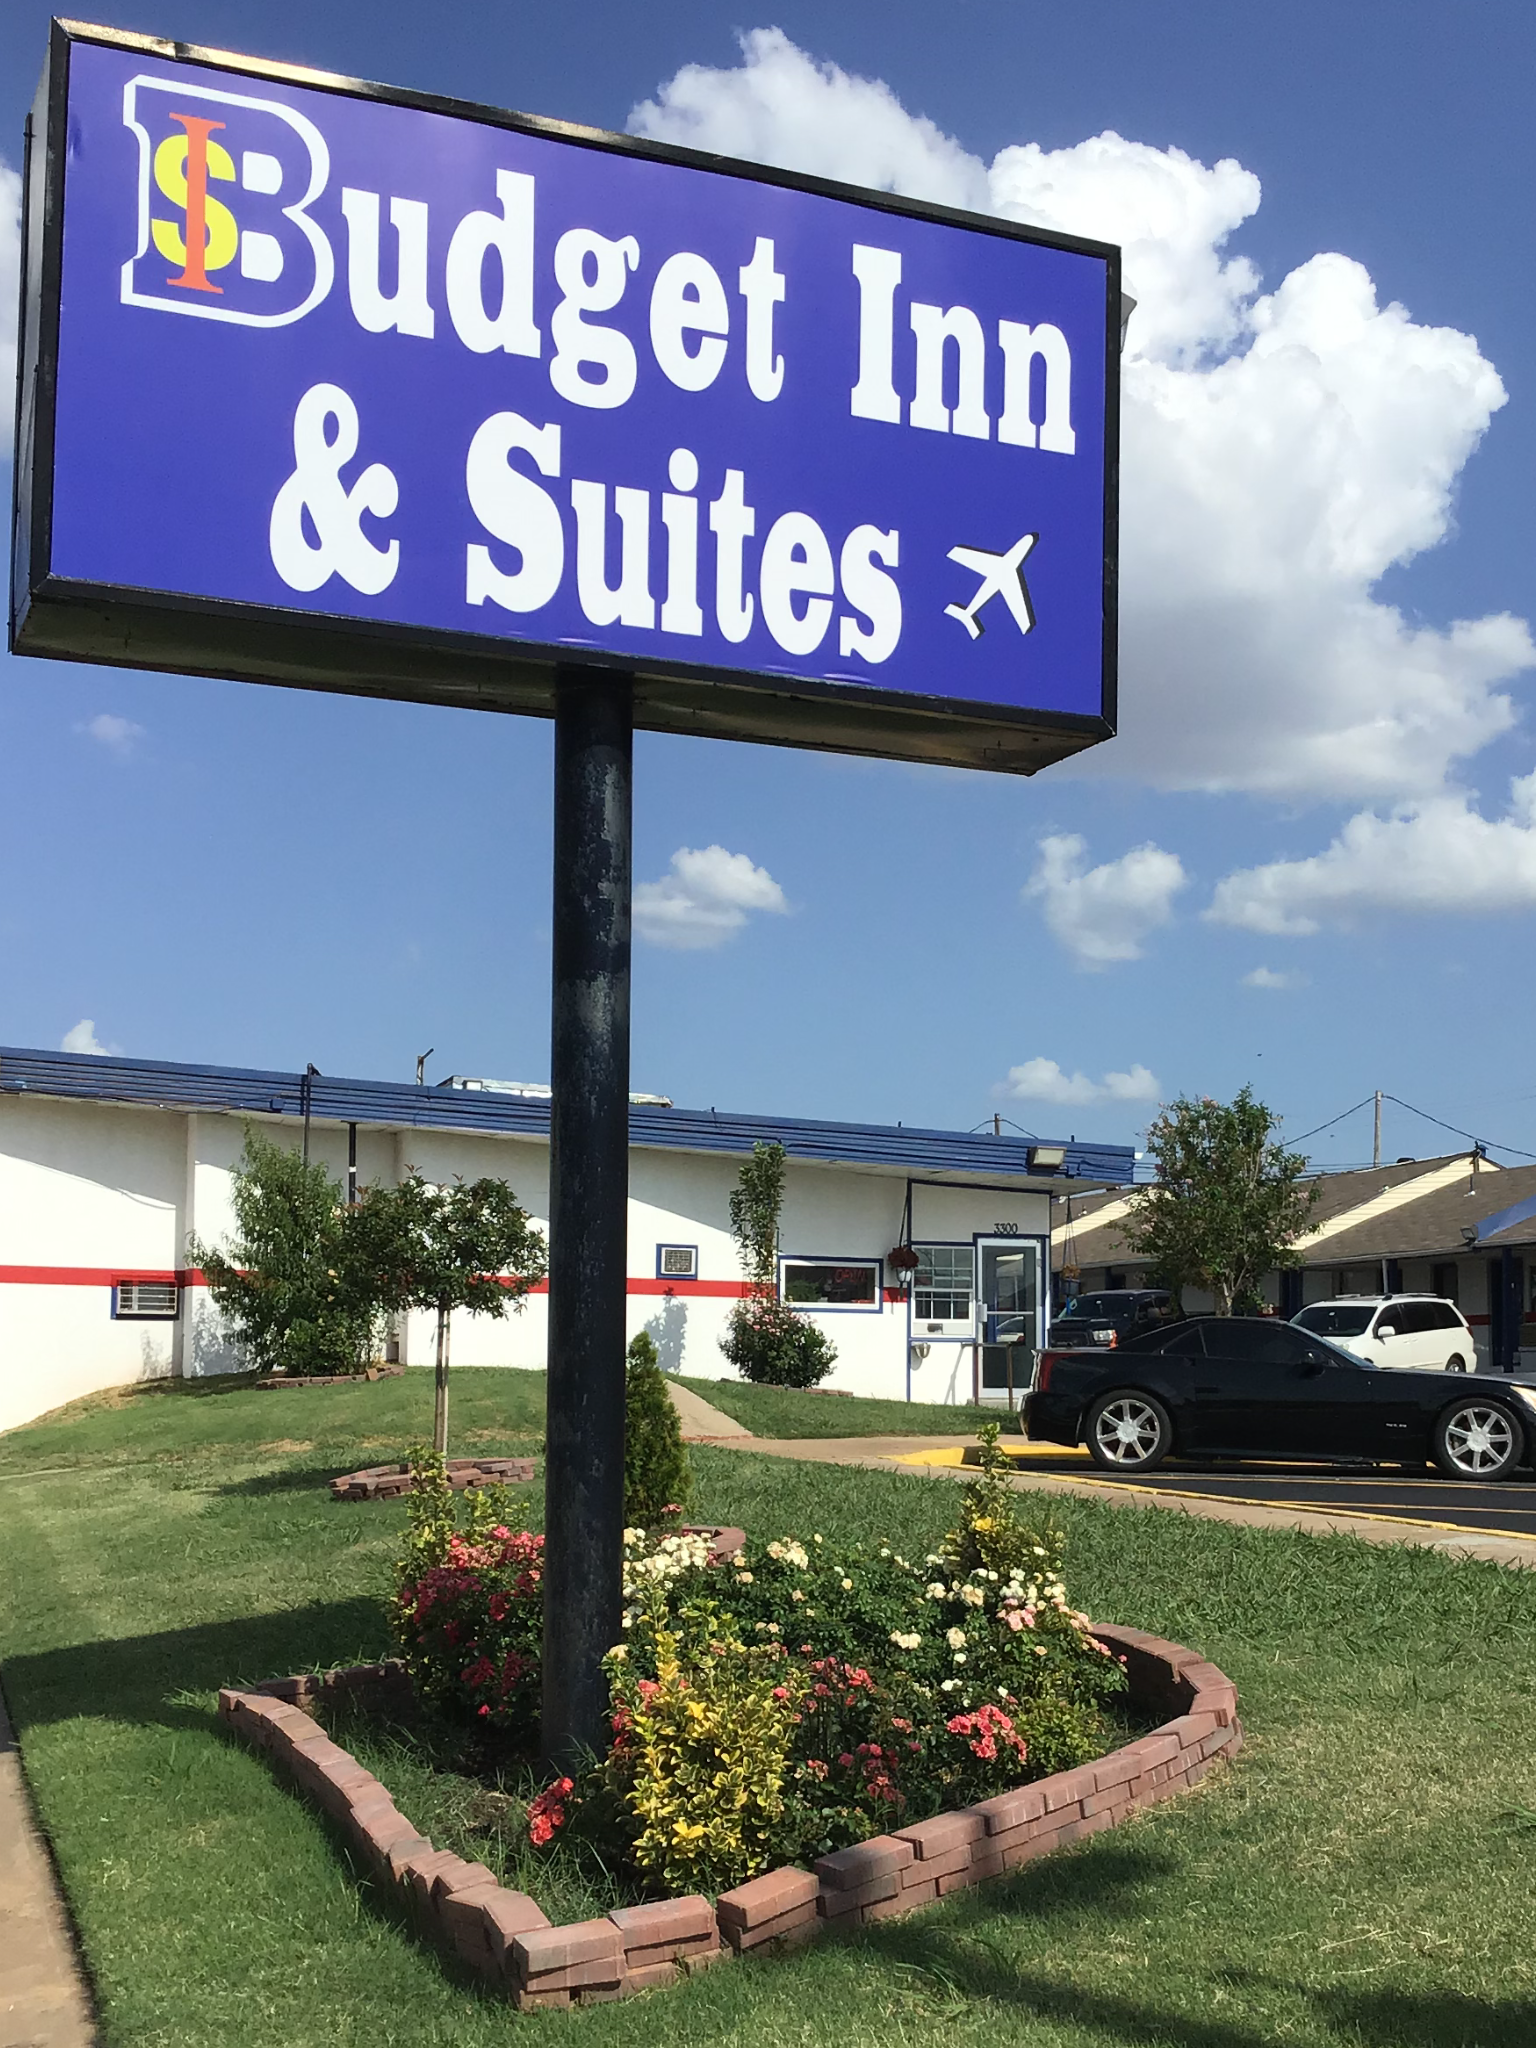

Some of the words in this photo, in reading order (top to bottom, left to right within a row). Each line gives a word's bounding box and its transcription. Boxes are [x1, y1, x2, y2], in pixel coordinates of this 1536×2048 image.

[120, 74, 786, 408] Budget
[851, 244, 1076, 456] Inn
[269, 383, 400, 596] &
[466, 412, 903, 664] Suites
[994, 1222, 1018, 1235] 3300
